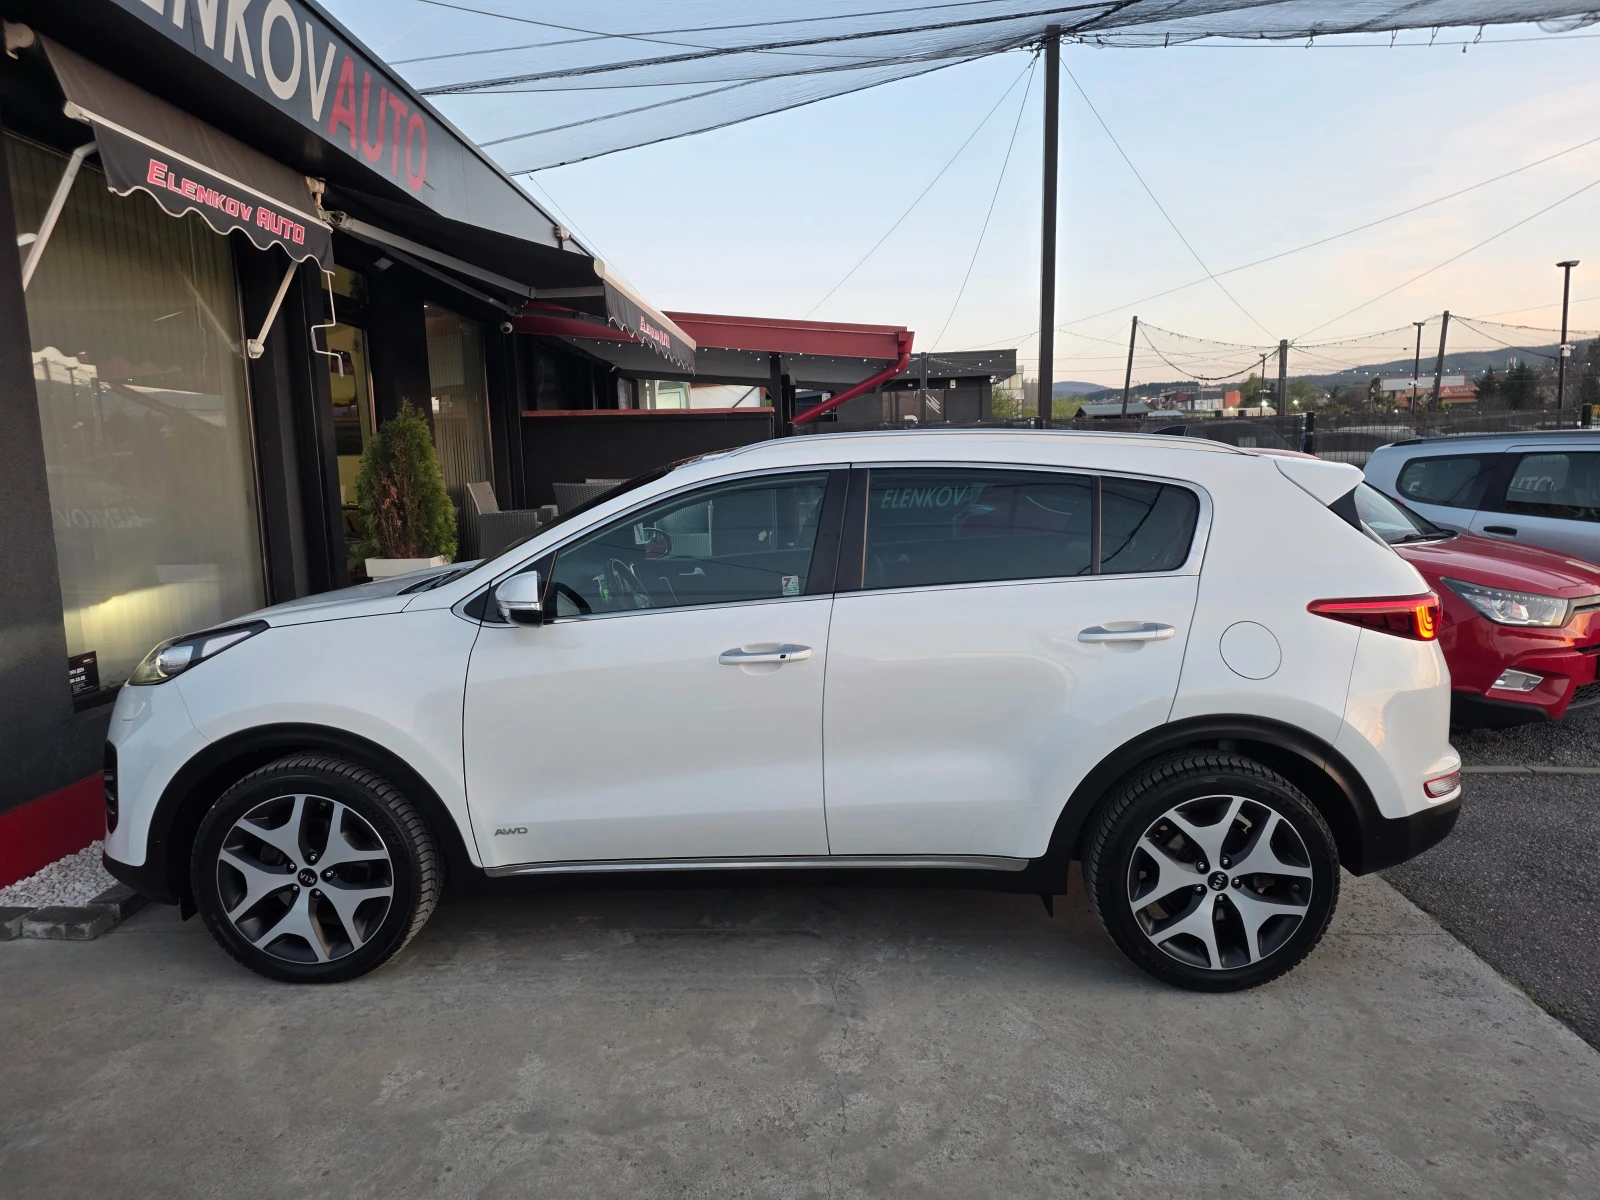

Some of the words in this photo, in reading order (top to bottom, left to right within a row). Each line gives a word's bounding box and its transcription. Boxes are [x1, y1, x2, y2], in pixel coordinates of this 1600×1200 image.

[328, 55, 428, 192] AUTO
[147, 158, 253, 222] ELENKOV
[256, 206, 305, 245] AUTO
[880, 486, 969, 509] ELENKOV
[494, 827, 528, 836] AWD
[301, 871, 316, 884] KIA
[1212, 874, 1225, 889] KIA
